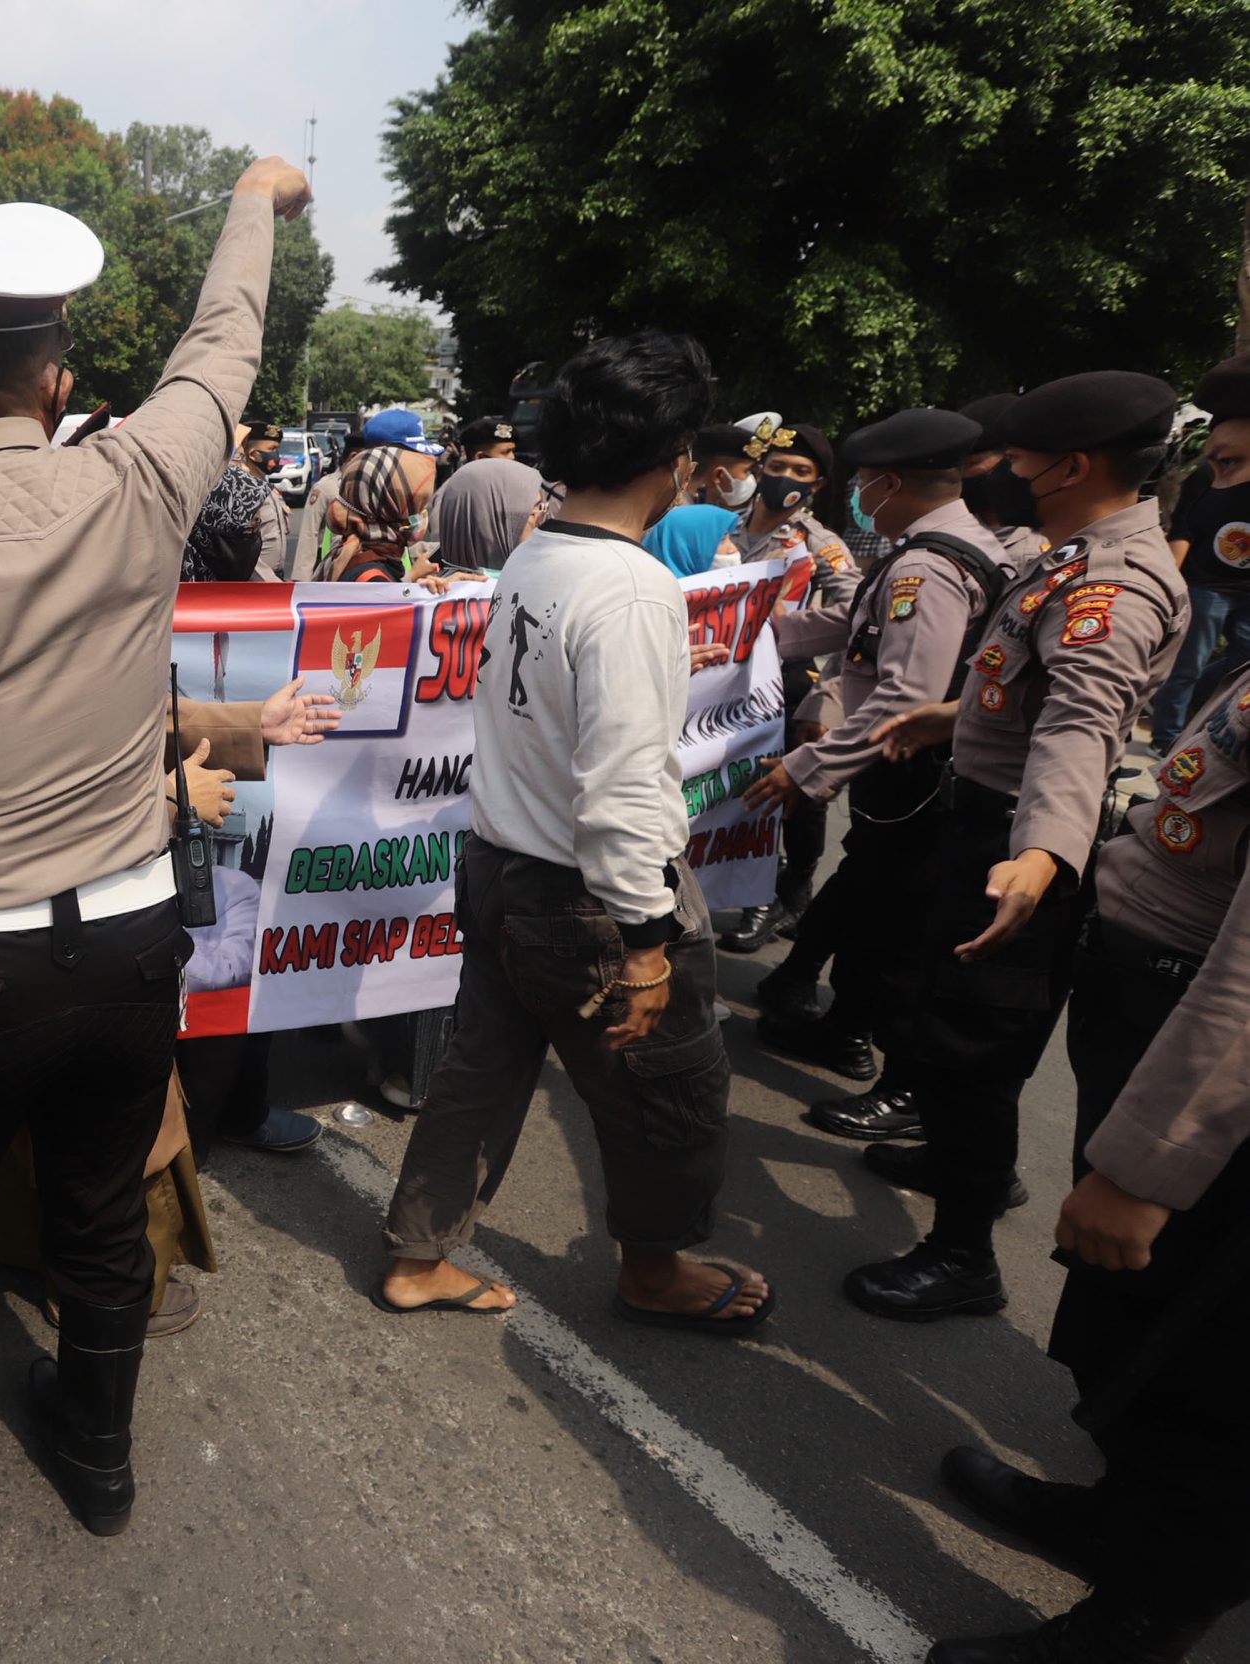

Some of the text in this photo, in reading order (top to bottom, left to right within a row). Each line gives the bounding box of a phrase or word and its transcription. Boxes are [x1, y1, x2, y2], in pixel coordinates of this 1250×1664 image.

[1067, 585, 1116, 601] POLDA
[285, 830, 450, 894] BEBASKAN
[259, 922, 338, 974] KAMI
[340, 916, 409, 967] SIAP
